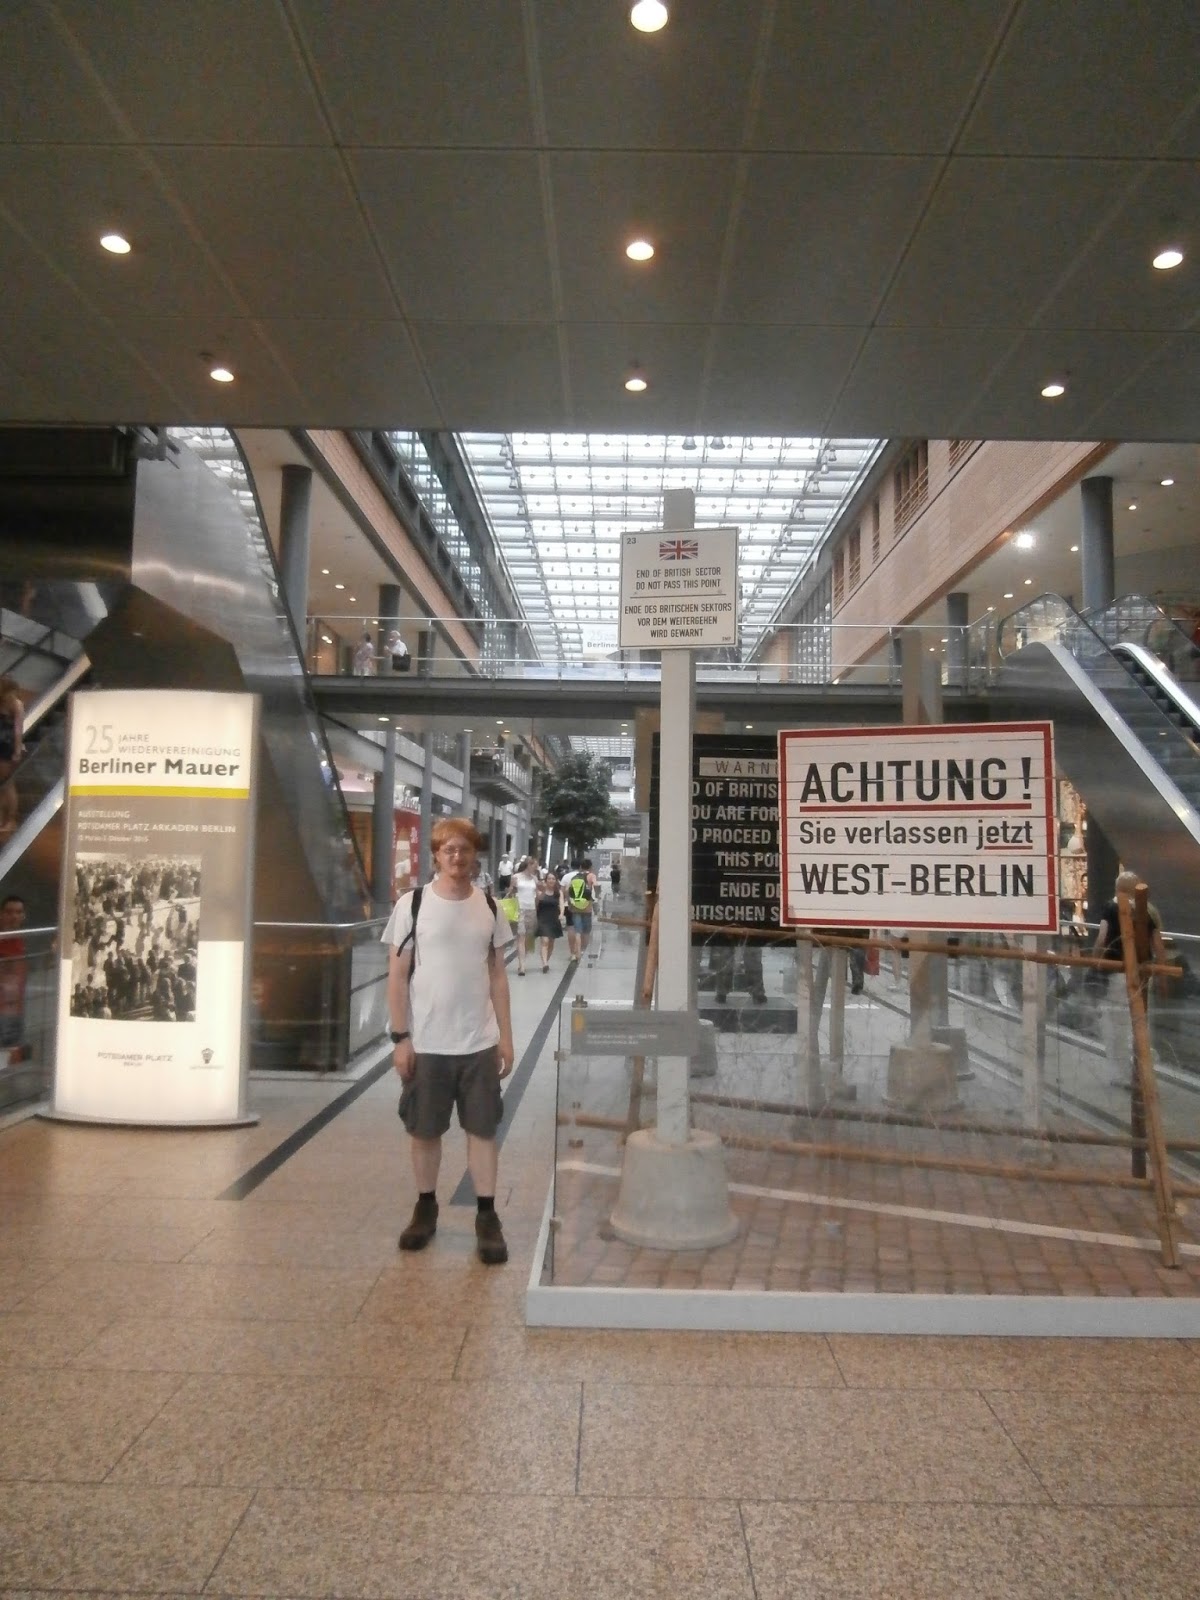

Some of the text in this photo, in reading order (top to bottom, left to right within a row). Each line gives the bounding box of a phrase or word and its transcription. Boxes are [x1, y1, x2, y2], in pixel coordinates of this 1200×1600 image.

[626, 537, 637, 545] 23
[636, 566, 721, 578] END OF BRITISH SECTOR
[636, 578, 721, 590] DO NOT PASS THIS POINT
[624, 602, 732, 614] ENDE DES BRITISCHEN SEKTORS
[637, 615, 718, 626] VOR DEM WEITERGEHEN
[650, 628, 704, 638] WIRD GEWARNT
[85, 724, 114, 755] 25
[118, 733, 150, 743] JAHRE
[118, 746, 241, 758] WIEDERVEREINIGUNG
[79, 757, 240, 777] Berliner Mauer
[705, 781, 724, 798] OF
[728, 782, 778, 799] BRITIS
[692, 804, 779, 822] OU ARE FOR
[122, 823, 150, 832] PLATZ
[152, 823, 199, 833] ARKADEN
[201, 824, 237, 834] BERLIN
[702, 827, 772, 845] PROCEED
[799, 818, 1033, 850] Sie verlassen jetzt
[715, 851, 780, 868] THIS POI
[800, 863, 1035, 898] WEST-BERLIN
[719, 881, 761, 898] ENDE
[770, 906, 780, 922] S
